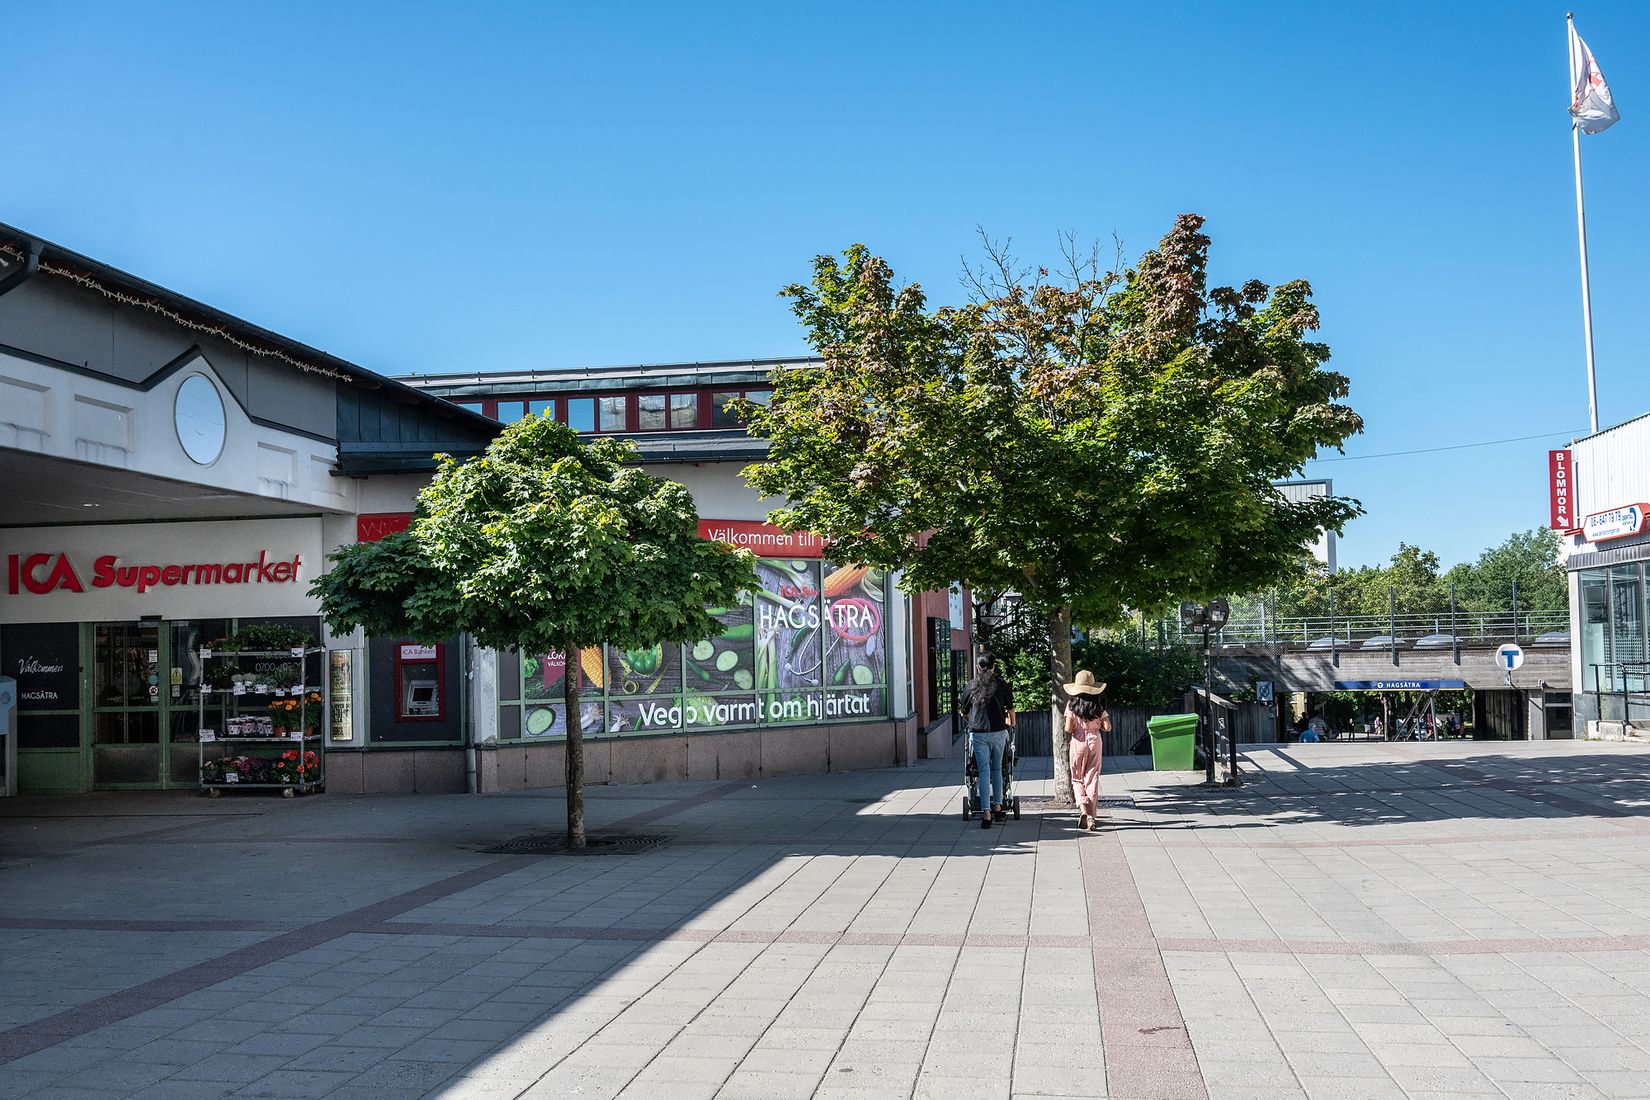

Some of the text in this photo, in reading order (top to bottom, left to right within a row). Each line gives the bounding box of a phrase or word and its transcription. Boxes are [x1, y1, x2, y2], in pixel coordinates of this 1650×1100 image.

[1556, 453, 1567, 514] BLOMMOR
[708, 528, 793, 545] Välkommen
[798, 531, 815, 546] till
[8, 550, 303, 595] ICA Supermarket
[760, 599, 873, 629] HAGSÄTRA
[18, 655, 63, 675] Välkommen
[255, 662, 275, 672] 0700
[1502, 650, 1519, 667] T
[21, 690, 58, 700] HAGSÄTRA
[638, 693, 870, 728] Vego varmt om hjärtat
